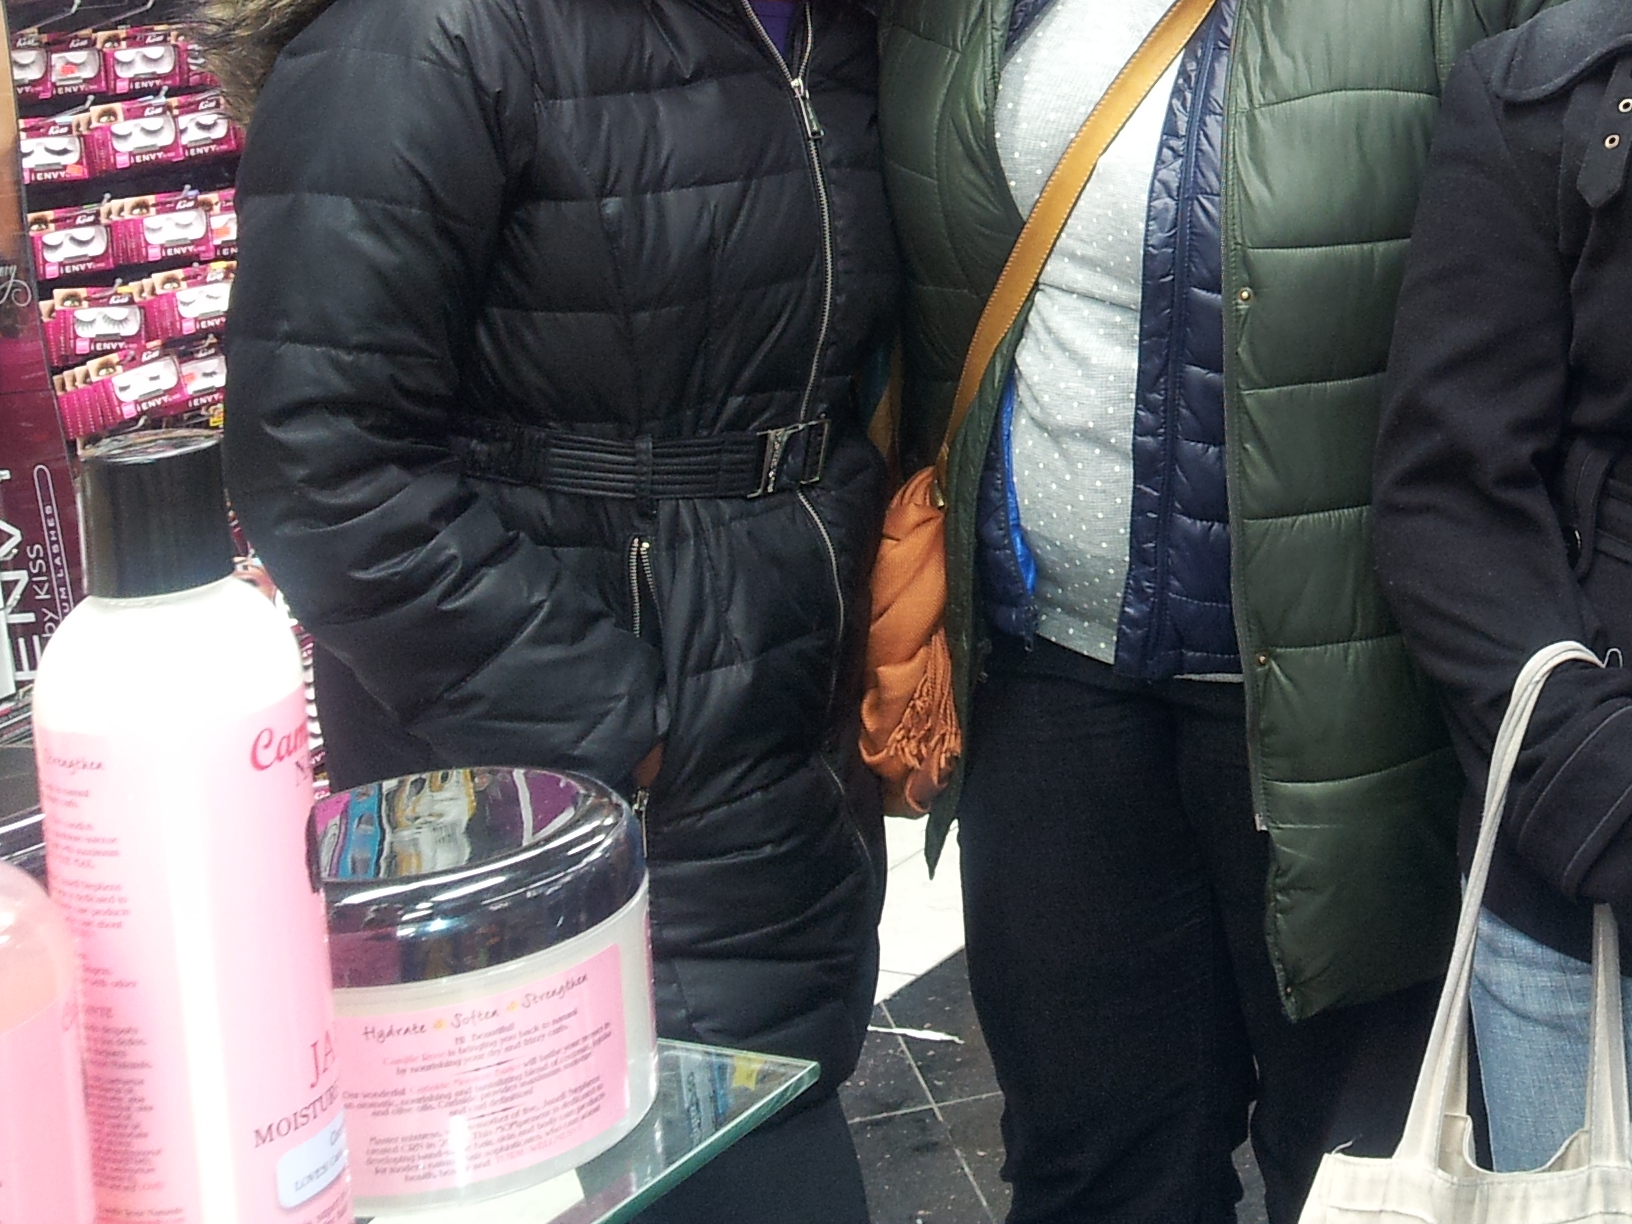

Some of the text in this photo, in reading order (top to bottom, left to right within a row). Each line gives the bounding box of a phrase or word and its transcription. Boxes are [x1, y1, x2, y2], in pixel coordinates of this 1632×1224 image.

[26, 543, 53, 600] KISS
[45, 504, 66, 579] LASHES
[361, 1023, 427, 1045] Hydrate
[450, 1007, 500, 1030] Soften
[521, 973, 589, 1008] Strengthen
